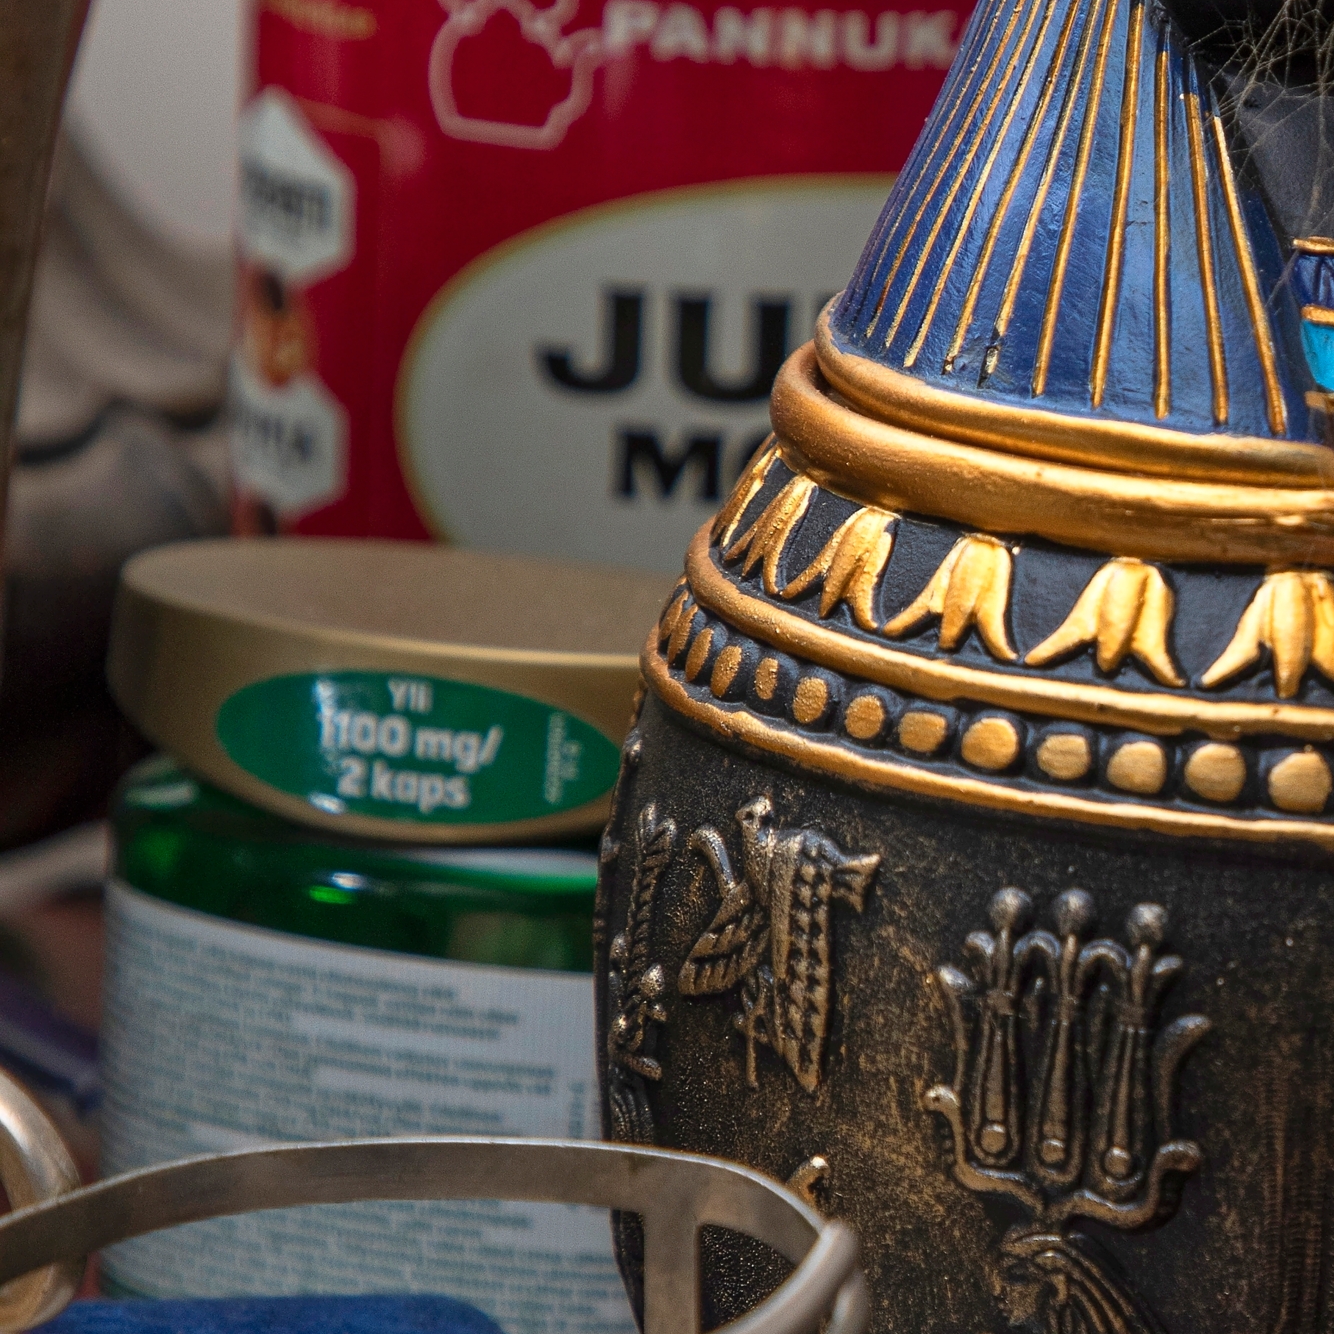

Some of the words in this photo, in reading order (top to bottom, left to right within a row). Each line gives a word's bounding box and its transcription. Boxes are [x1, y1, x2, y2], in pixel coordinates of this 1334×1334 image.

[538, 282, 838, 404] JU
[319, 710, 412, 758] 1100
[337, 755, 369, 798] 2
[370, 760, 471, 815] kaps
